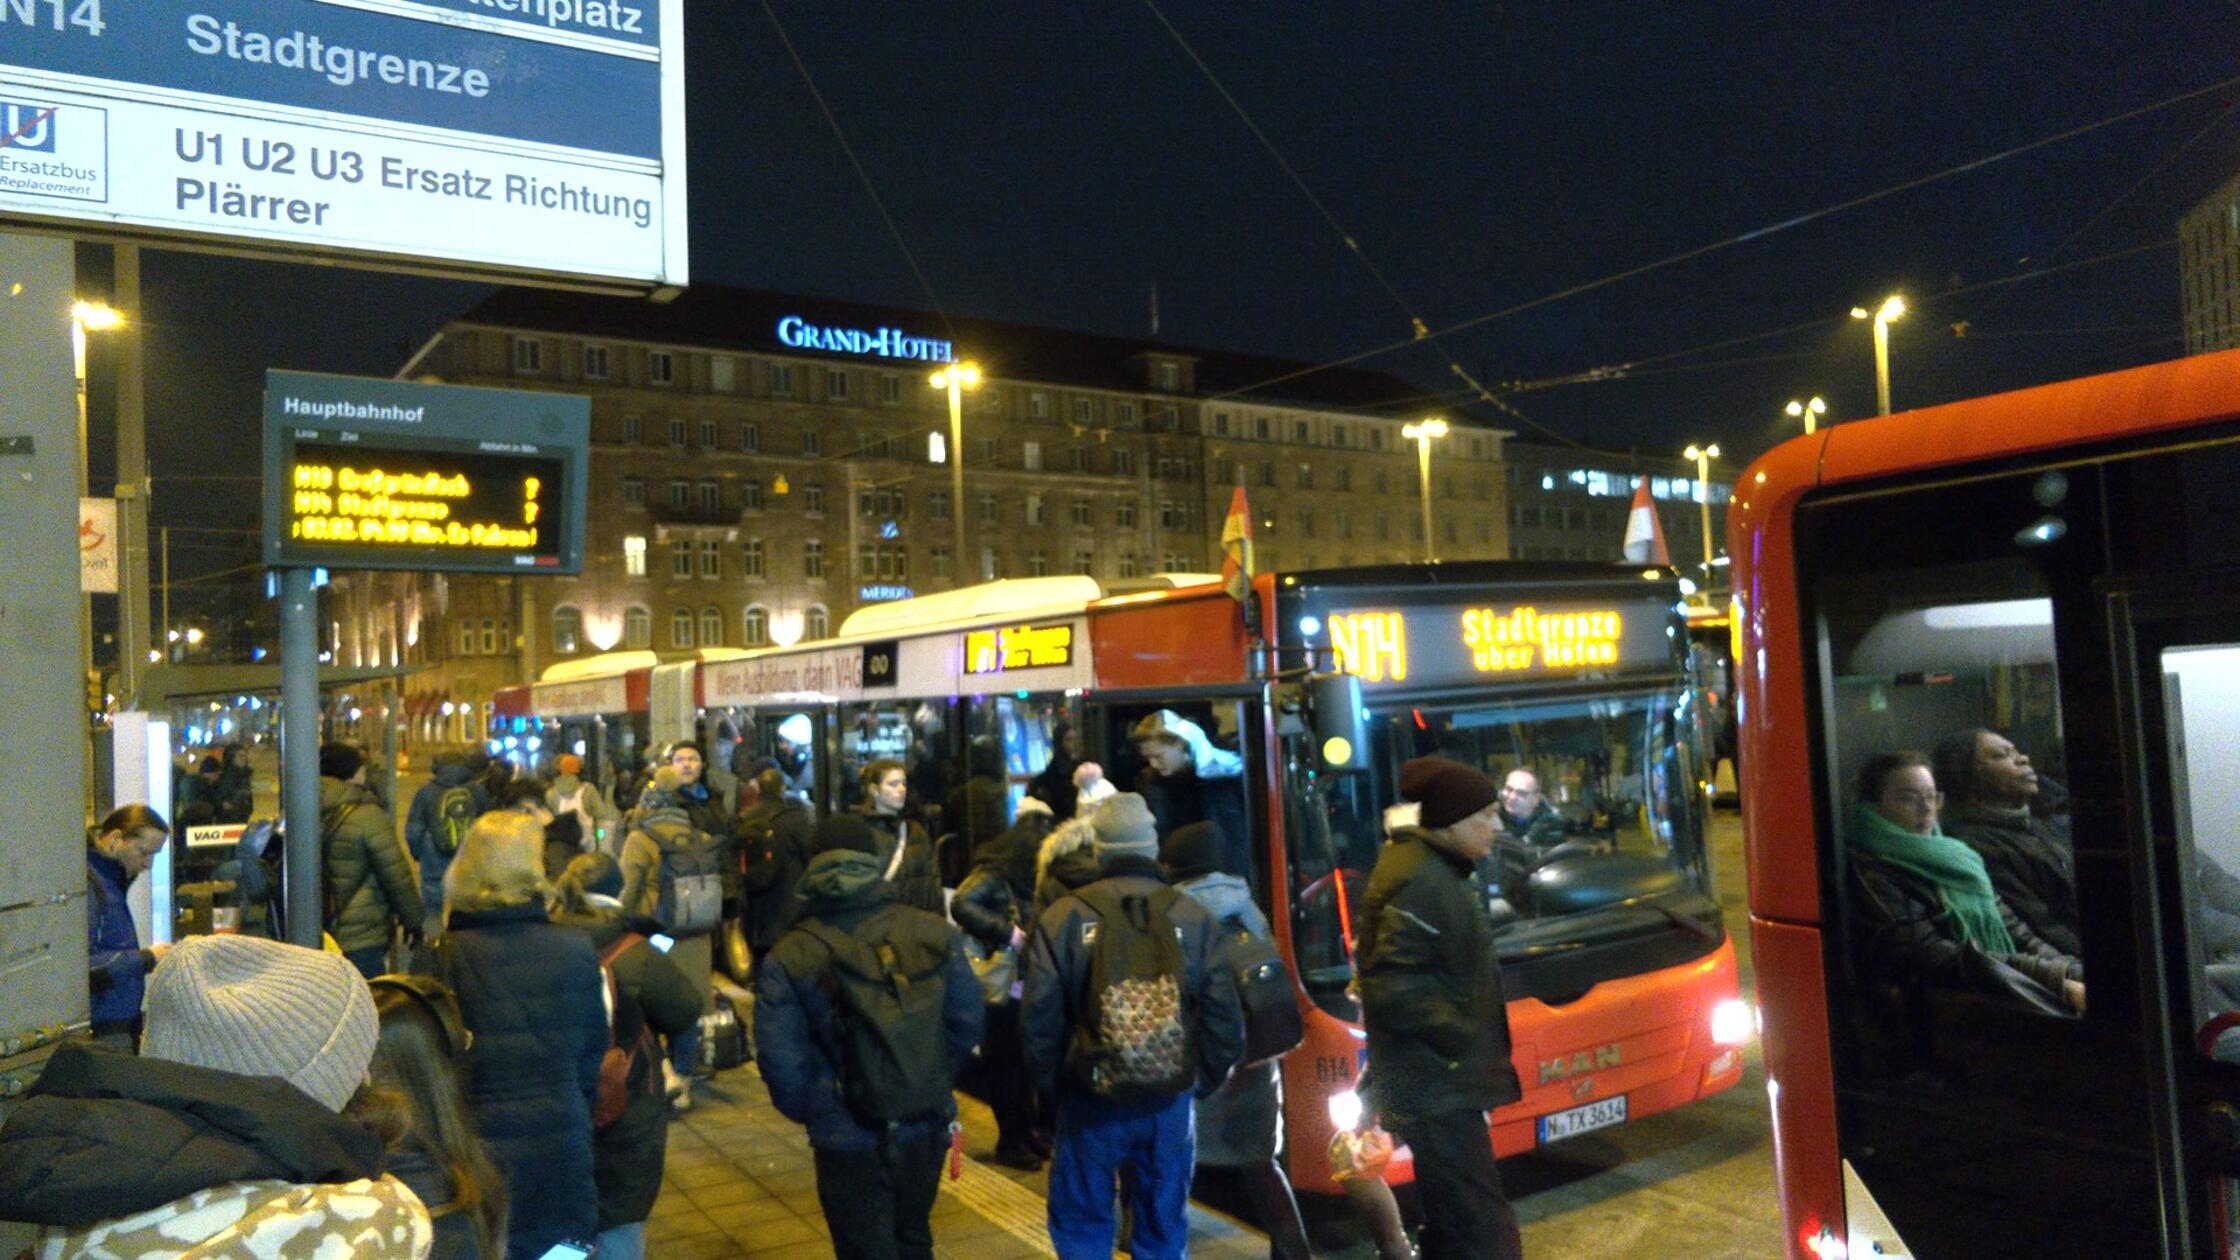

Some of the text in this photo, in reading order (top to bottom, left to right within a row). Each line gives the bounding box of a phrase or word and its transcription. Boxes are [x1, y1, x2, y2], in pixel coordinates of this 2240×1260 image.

[186, 13, 490, 98] Stadtgrenze
[0, 156, 97, 182] Ersatzbus
[0, 176, 91, 196] Replacement
[175, 127, 652, 229] U1 U2 U3 Ersatz Richtung
[175, 176, 330, 226] Plärrer
[284, 397, 425, 422] Hauptbahnhof
[1463, 607, 1621, 645] Stadtgrenze
[836, 654, 862, 689] VAG
[194, 830, 221, 841] VAG
[1539, 1043, 1621, 1084] MAN
